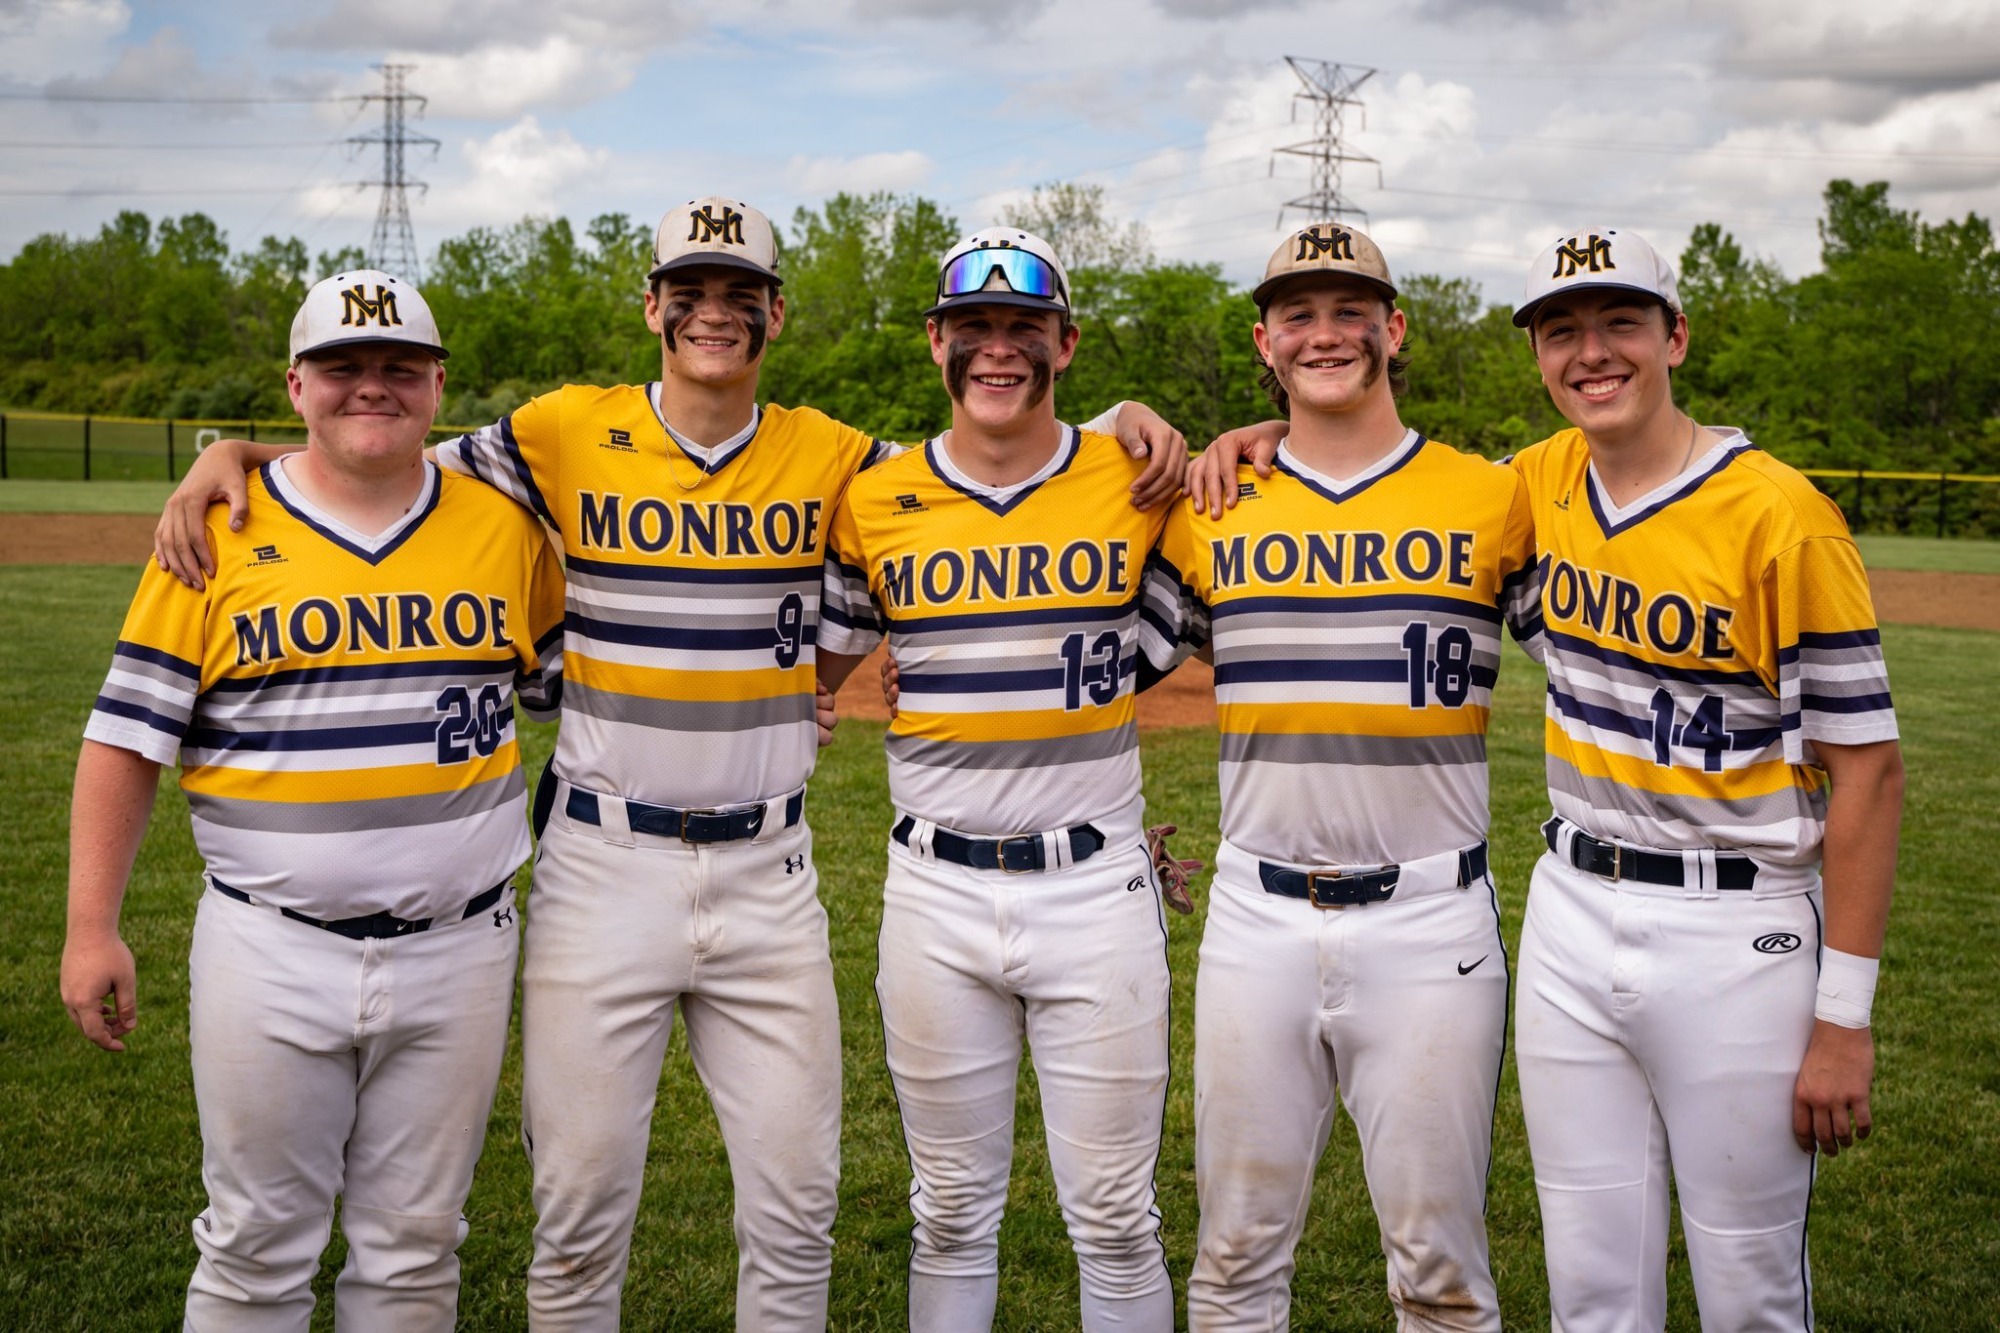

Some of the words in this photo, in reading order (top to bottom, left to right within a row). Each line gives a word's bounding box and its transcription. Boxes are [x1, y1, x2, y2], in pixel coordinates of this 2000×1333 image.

[599, 443, 639, 453] PROLOOK
[577, 489, 824, 559] MONROE
[892, 506, 930, 516] PROLOOK
[247, 557, 289, 567] PROLOOK
[881, 538, 1130, 611] MONROE
[1209, 527, 1477, 593] MONROE
[229, 589, 514, 666] MONROE
[774, 590, 804, 671] 9
[1400, 620, 1473, 710] 18
[1058, 628, 1122, 712] 13
[434, 682, 502, 768] 20
[1647, 685, 1734, 774] 14
